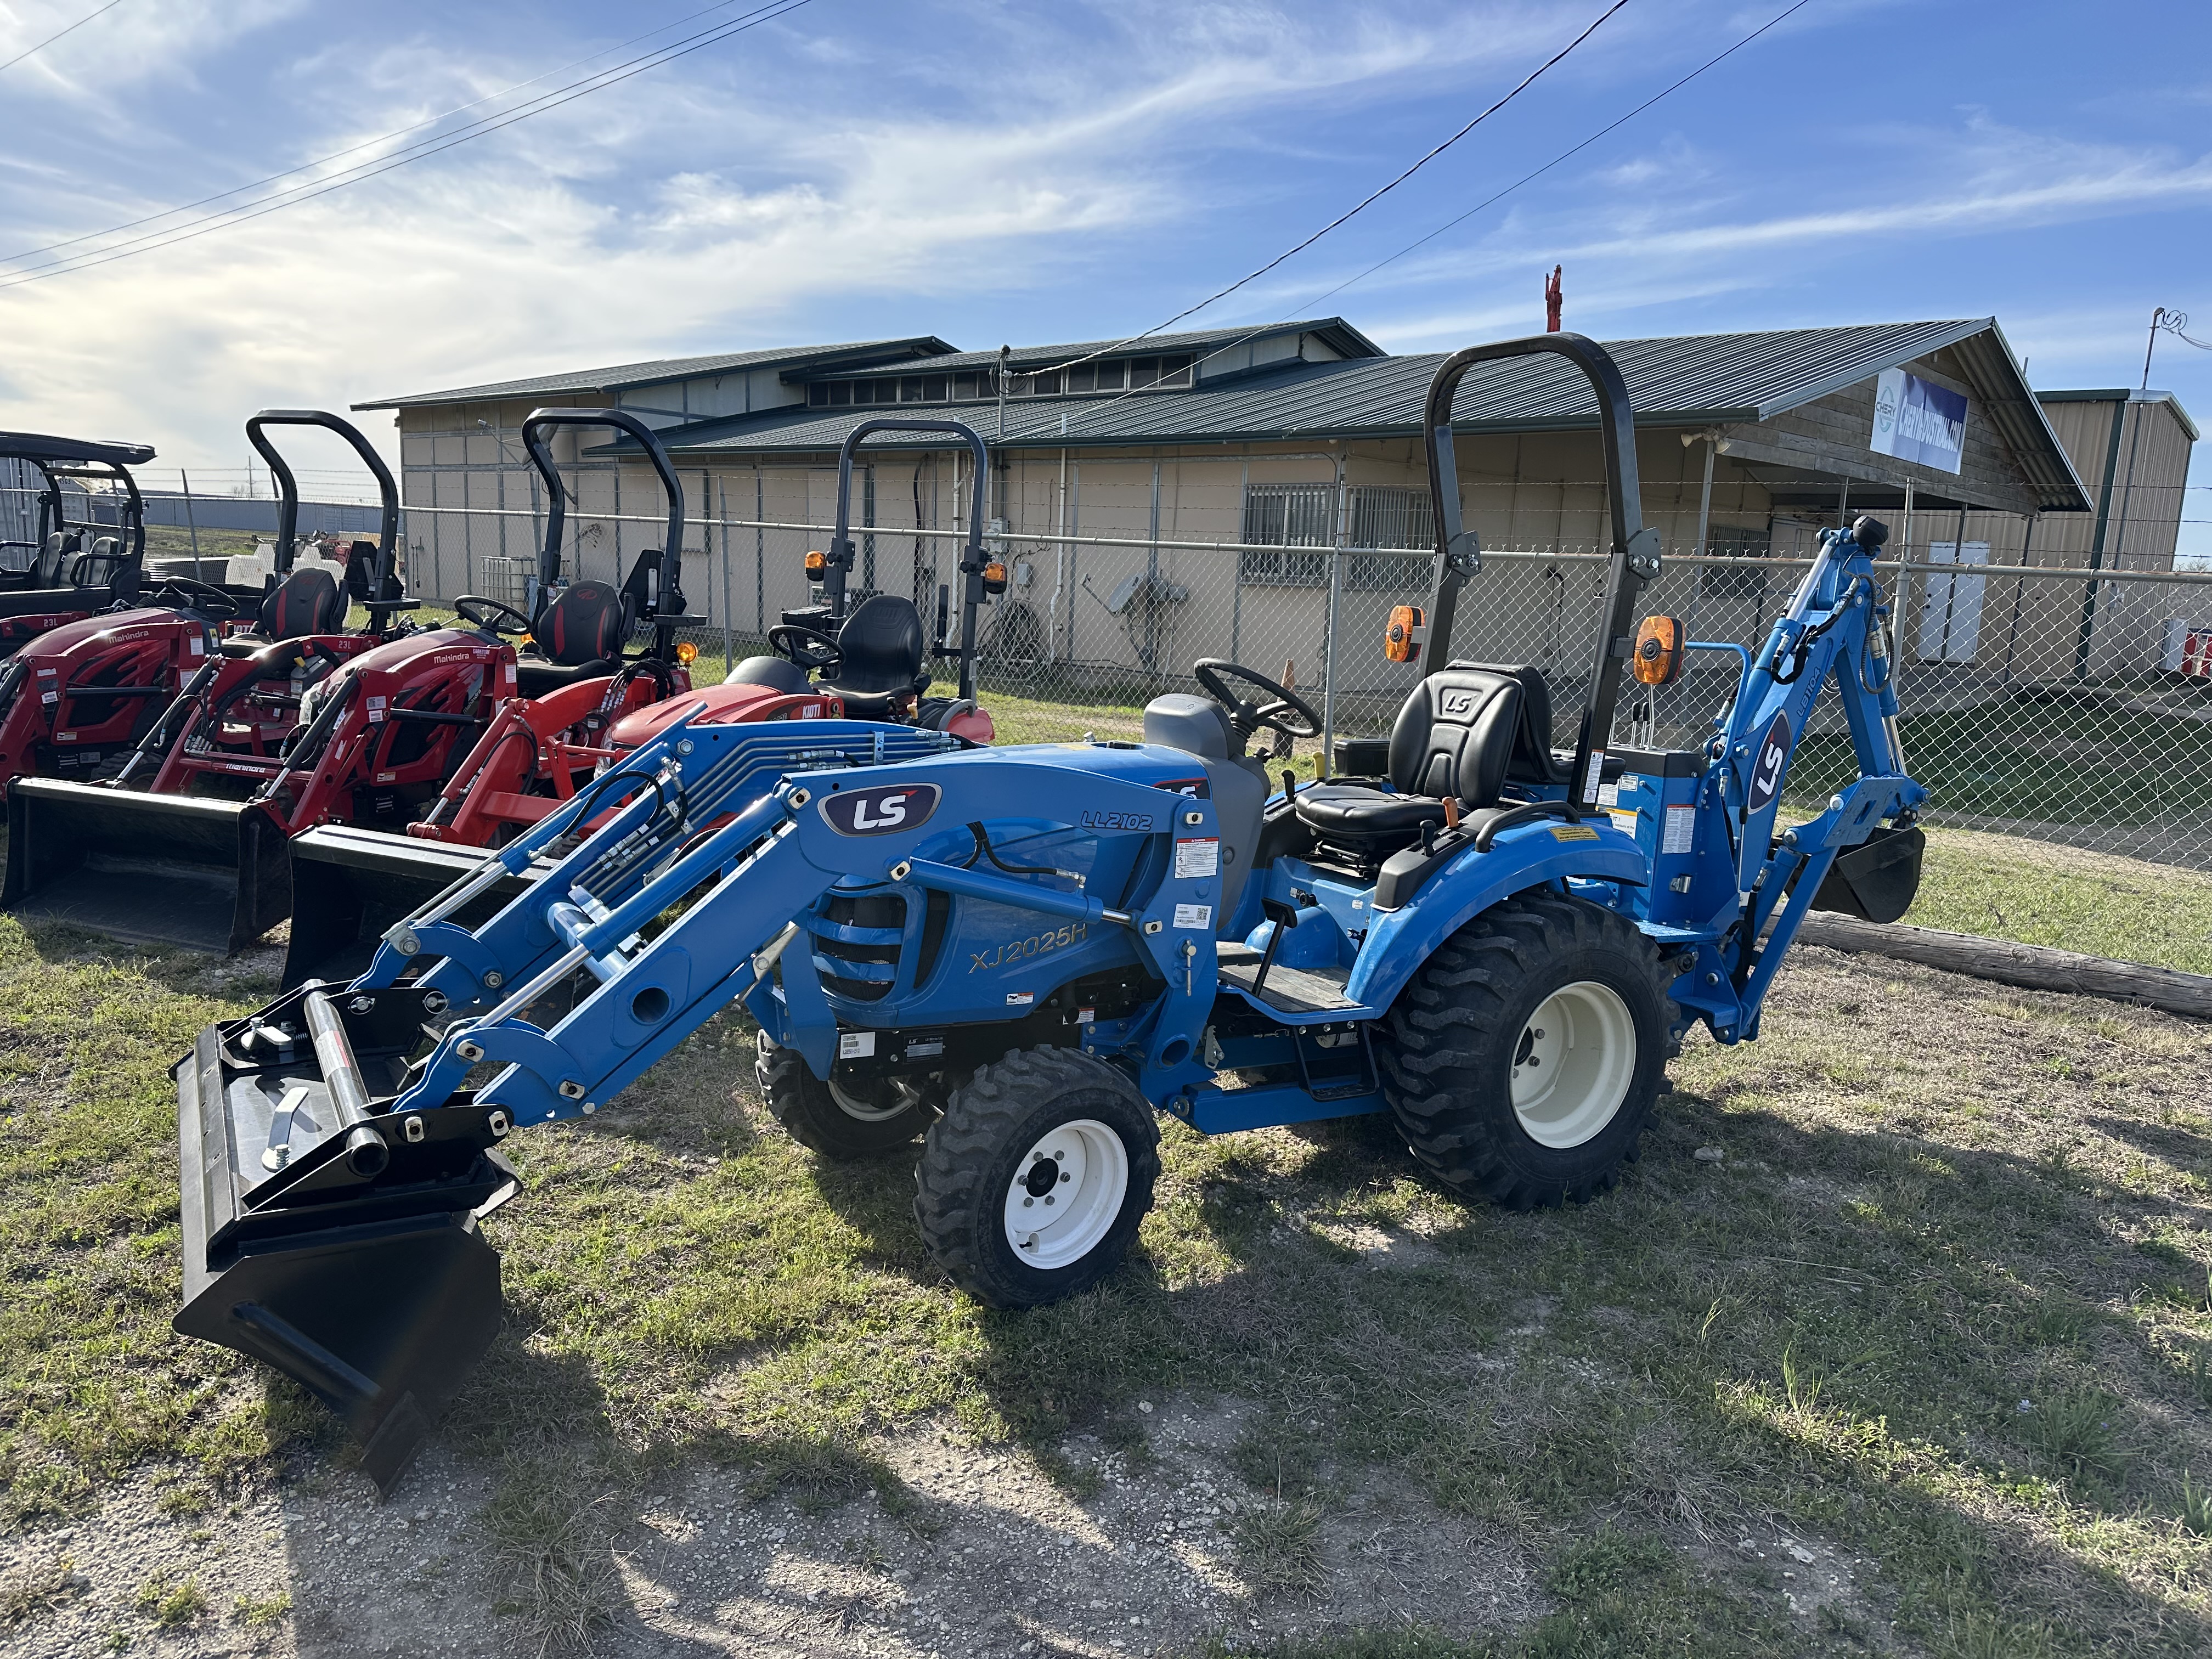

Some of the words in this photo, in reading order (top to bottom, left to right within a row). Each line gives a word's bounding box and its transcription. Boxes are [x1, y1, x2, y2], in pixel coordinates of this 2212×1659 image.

[1876, 401, 1896, 417] CHERY
[43, 618, 58, 627] 23L
[338, 640, 351, 649] 23L
[1797, 666, 1821, 718] LB1104
[802, 703, 821, 719] KIOTI
[1444, 693, 1472, 713] LS
[1757, 742, 1783, 795] LS
[853, 794, 906, 830] LS
[1080, 810, 1153, 832] LL2102
[967, 922, 1088, 975] XJ2025H
